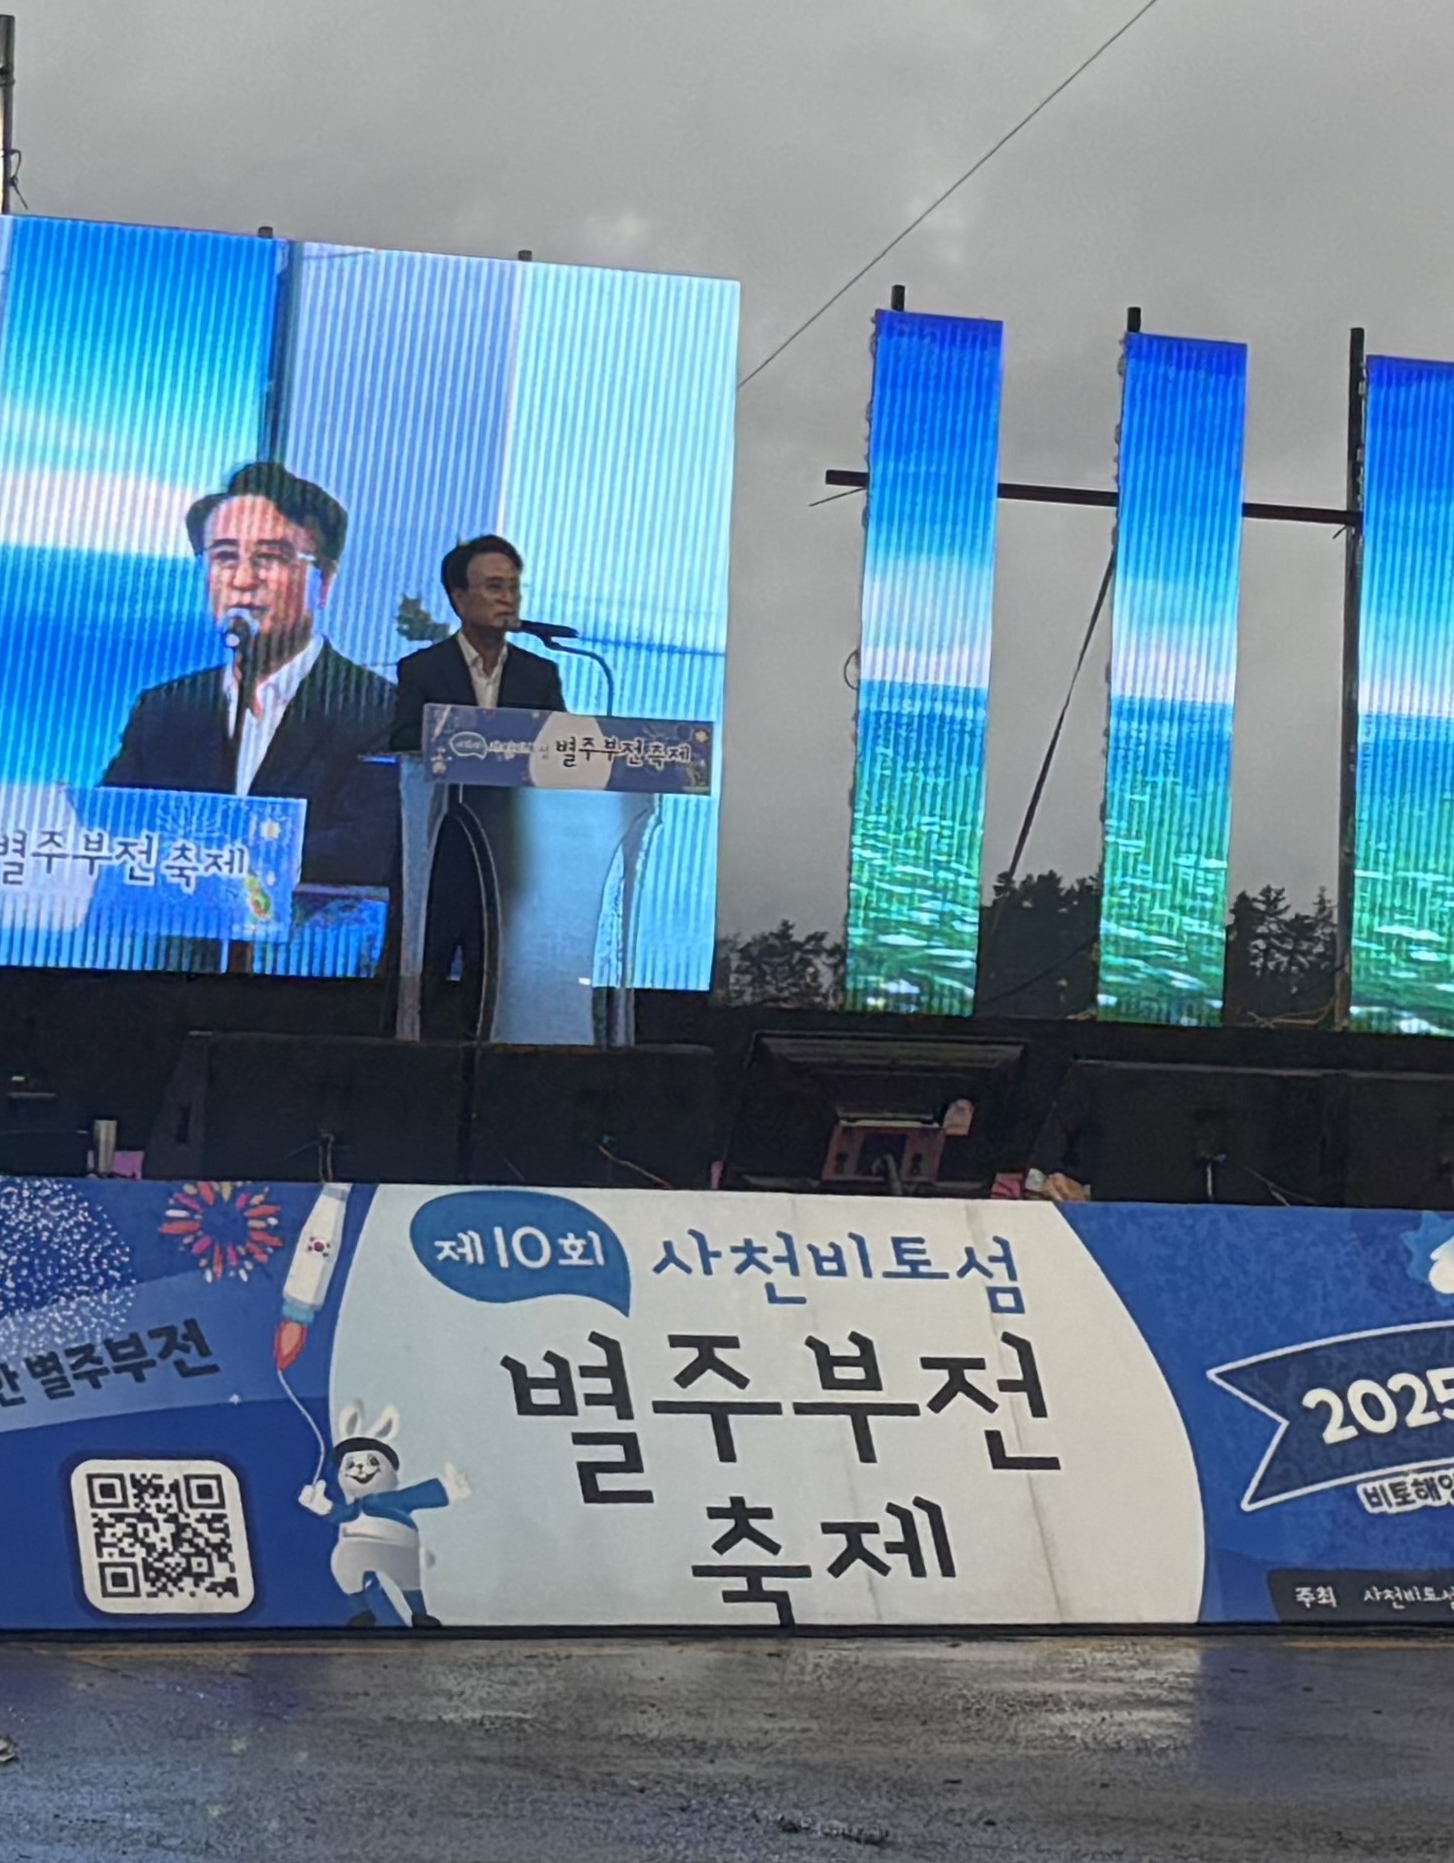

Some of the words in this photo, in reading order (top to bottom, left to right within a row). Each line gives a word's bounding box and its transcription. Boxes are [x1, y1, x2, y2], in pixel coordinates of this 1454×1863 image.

[555, 735, 644, 768] 별주부전
[646, 742, 692, 770] 축제
[161, 842, 249, 892] 축제
[434, 1223, 607, 1270] 제10회
[650, 1230, 1026, 1316] 사천비토섬
[23, 1317, 221, 1401] 별주부전
[498, 1329, 1062, 1505] 별주부전
[690, 1494, 957, 1626] 축제
[1294, 1584, 1338, 1610] 주최
